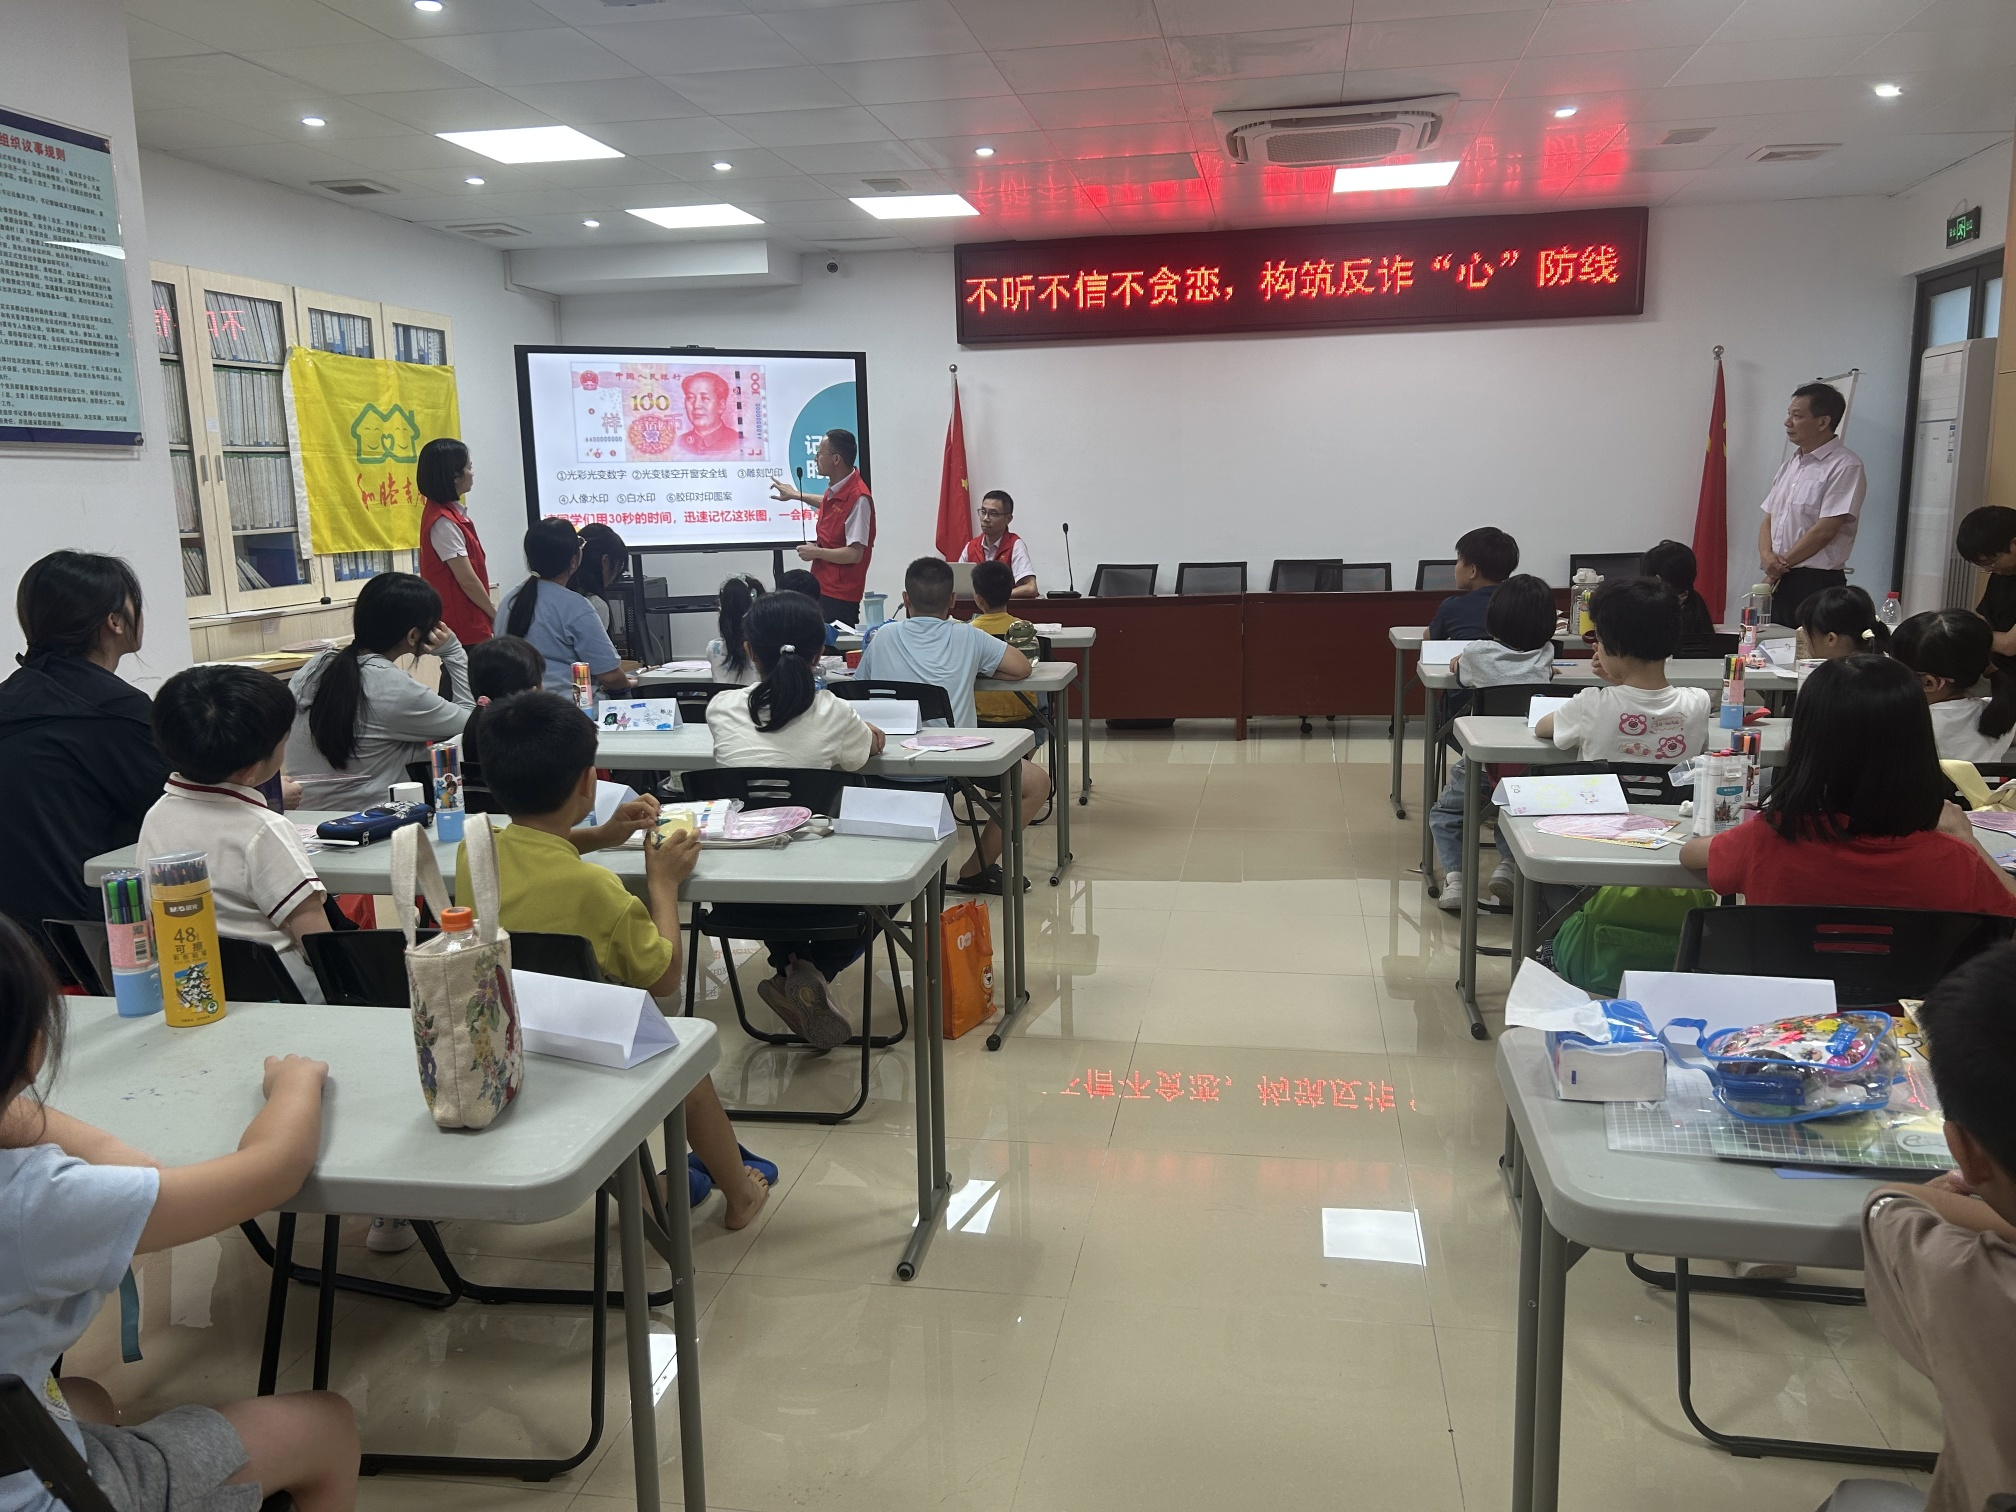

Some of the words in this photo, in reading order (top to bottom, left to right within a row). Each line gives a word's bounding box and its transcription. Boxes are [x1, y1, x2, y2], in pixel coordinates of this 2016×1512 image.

[0, 131, 65, 161] 组织议事规则
[631, 394, 670, 411] 100
[559, 494, 609, 505] ④人像水印
[617, 493, 656, 504] ⑤白水印
[174, 927, 197, 943] 48
